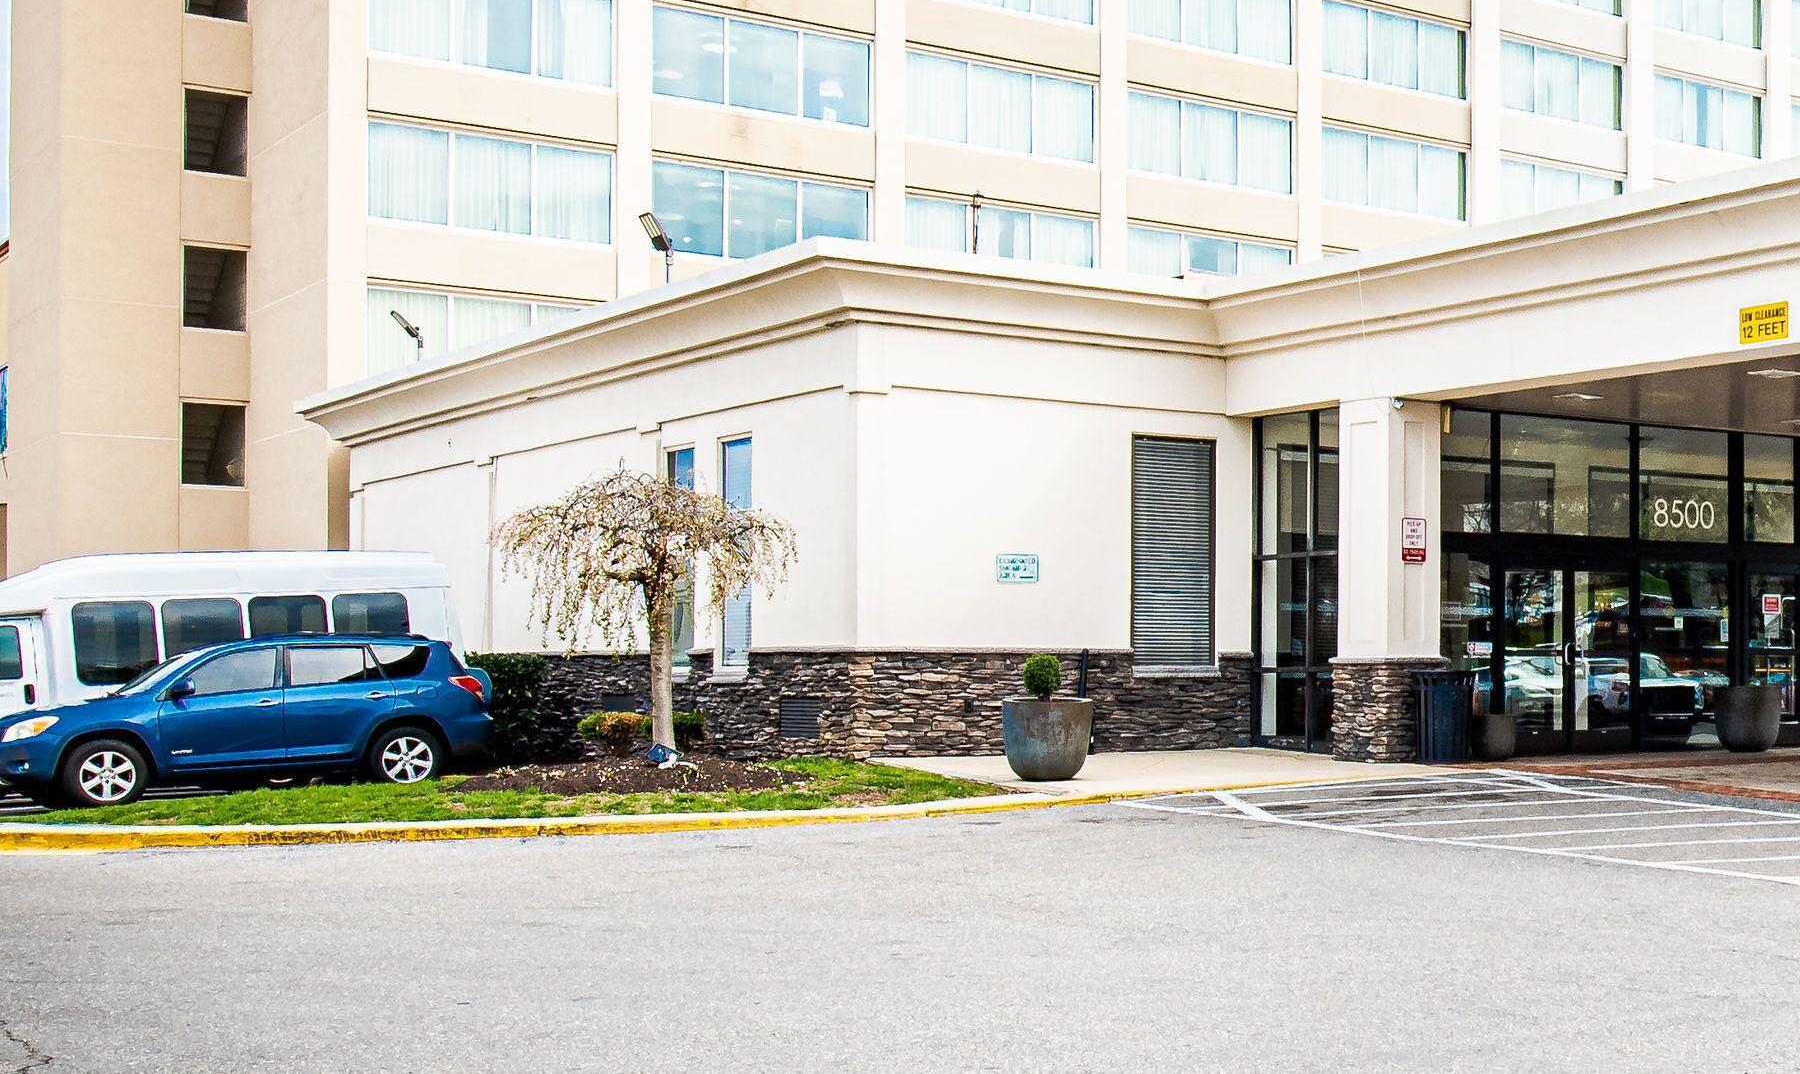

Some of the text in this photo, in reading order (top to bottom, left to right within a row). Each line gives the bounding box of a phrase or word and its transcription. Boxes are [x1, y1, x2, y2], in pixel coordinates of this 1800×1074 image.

[1742, 306, 1786, 323] LOW CLEARANCE
[1742, 320, 1786, 339] 12 FEET
[1653, 498, 1715, 530] 8500
